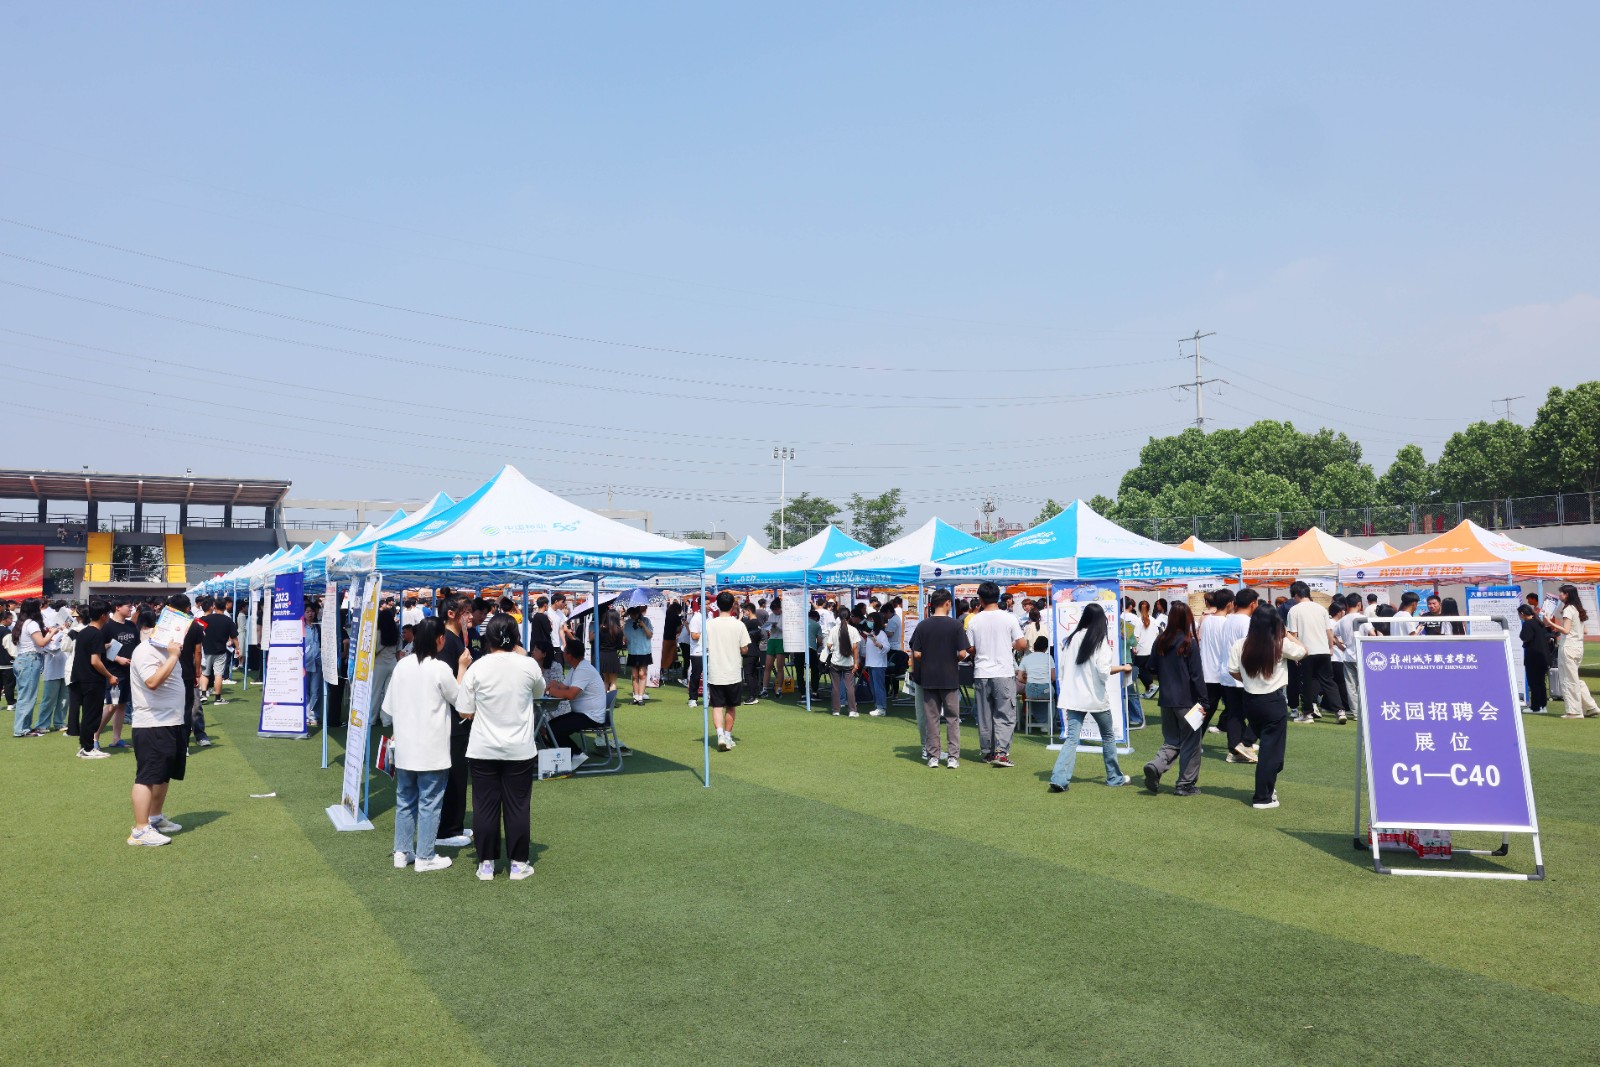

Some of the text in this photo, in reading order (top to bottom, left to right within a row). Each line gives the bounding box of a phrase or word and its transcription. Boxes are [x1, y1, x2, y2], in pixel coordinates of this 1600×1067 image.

[451, 549, 641, 569] 全国9.5亿用户的共同选择
[275, 592, 289, 602] 2023
[1380, 701, 1499, 721] 校园招聘会
